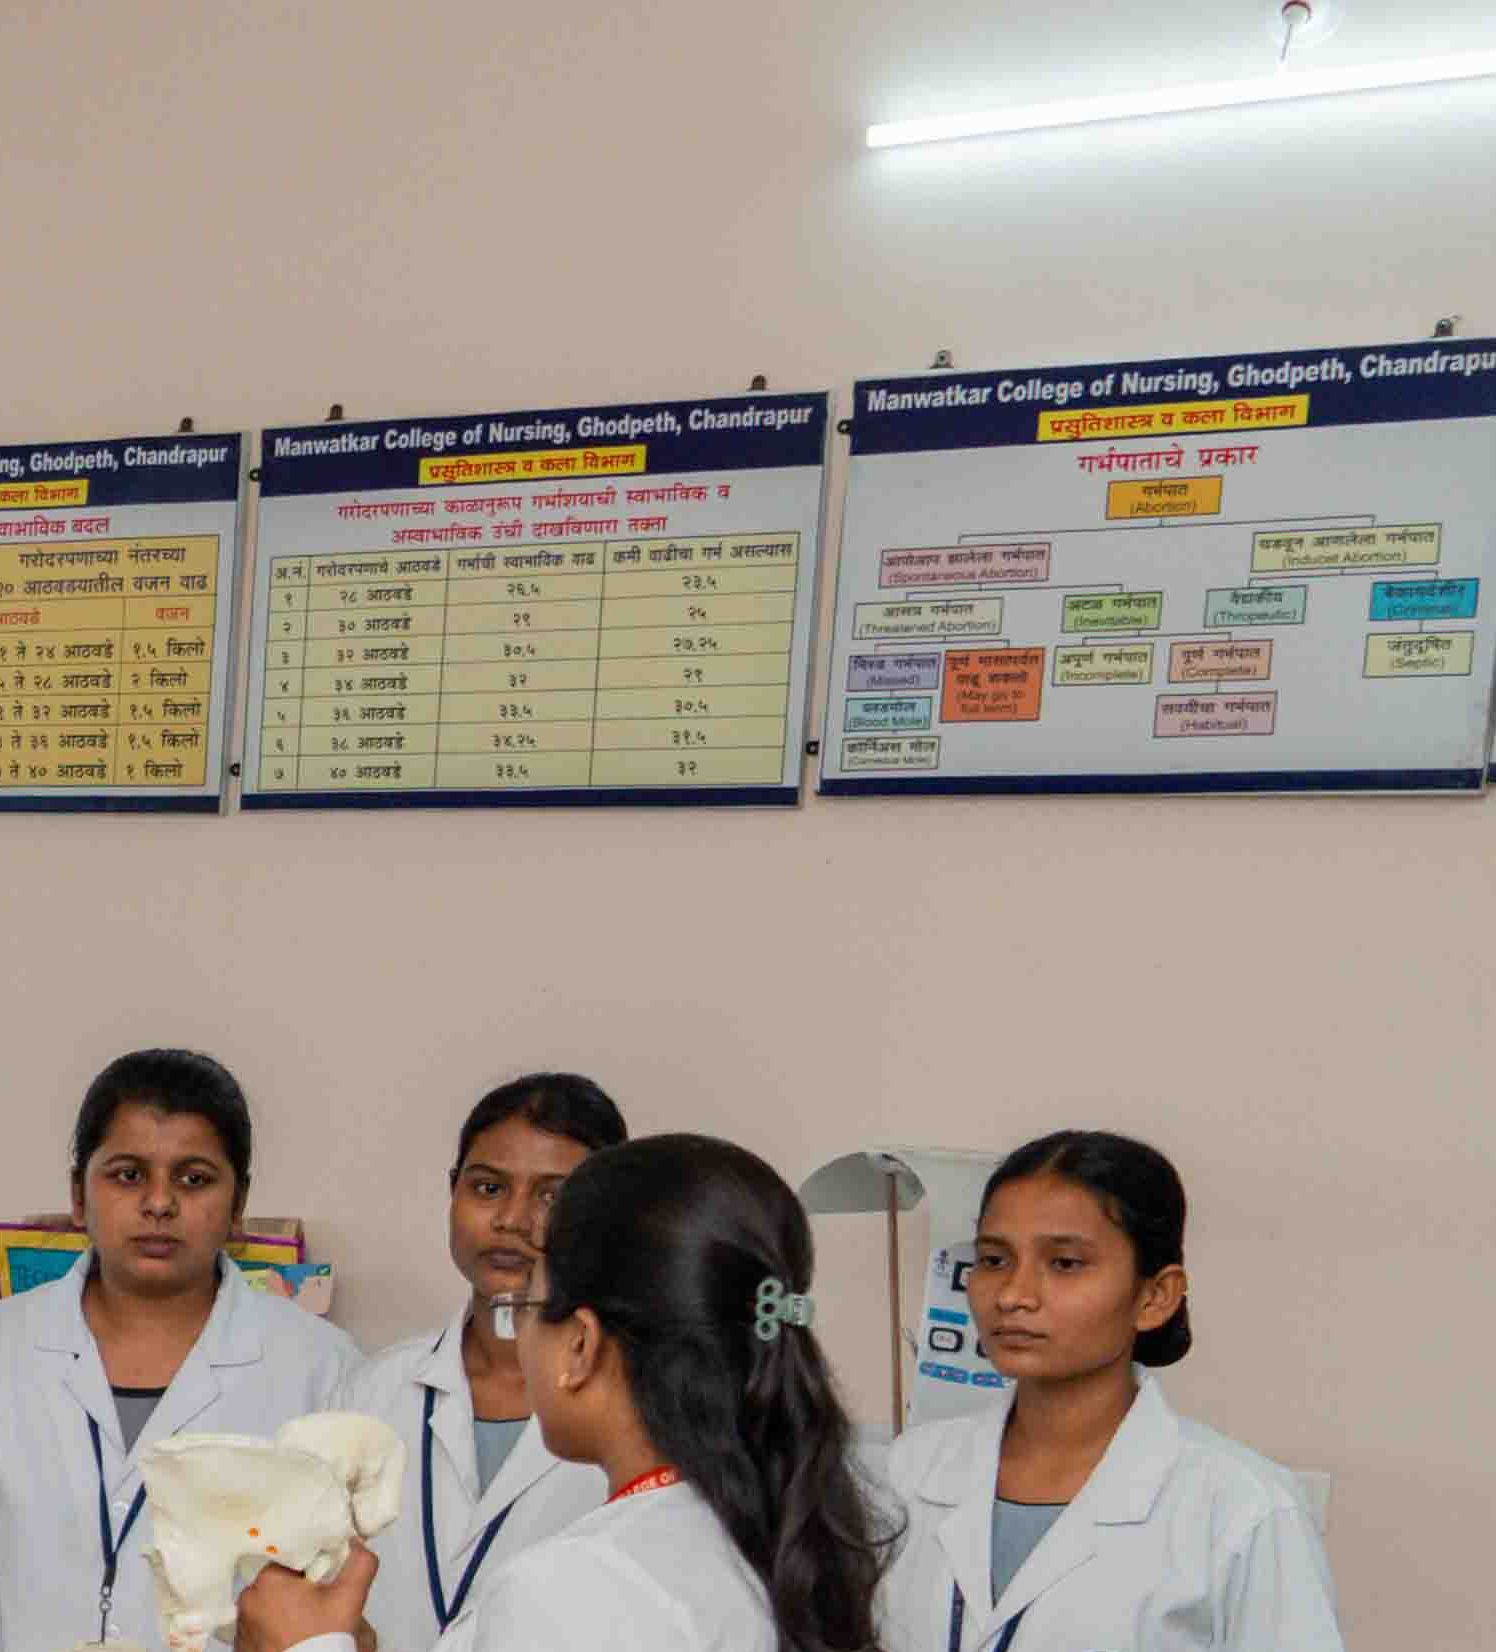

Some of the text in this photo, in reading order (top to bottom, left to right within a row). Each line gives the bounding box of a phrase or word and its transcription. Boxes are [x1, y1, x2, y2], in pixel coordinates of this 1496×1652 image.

[868, 384, 992, 412] Manwatkar
[997, 379, 1083, 405] College
[1090, 374, 1114, 396] of
[1122, 367, 1220, 395] Nursing,
[1228, 357, 1353, 389] Ghodpeth,
[1161, 412, 1174, 426] व
[1182, 409, 1226, 425] कला
[1234, 403, 1295, 422] विभाग
[274, 406, 812, 457] Manwatkar College of Nursing, Ghodpeth, Chandrapur
[30, 450, 119, 475] Ghodpeth,
[124, 445, 227, 468] Chandrapur
[523, 452, 635, 473] व कला विभाग
[1078, 443, 1258, 473] गर्भपाताचे प्रकार
[718, 484, 730, 499] व
[72, 516, 111, 534] बदल
[64, 639, 114, 659] आठवडे
[166, 636, 205, 657] किलो
[63, 668, 112, 689] आठवडे
[150, 666, 188, 687] किलो
[61, 698, 111, 719] आठवडे
[163, 697, 202, 718] किलो
[59, 728, 108, 750] आठवडे
[162, 727, 200, 748] किलो
[58, 758, 107, 779] आठवडे
[144, 759, 183, 779] किलो
